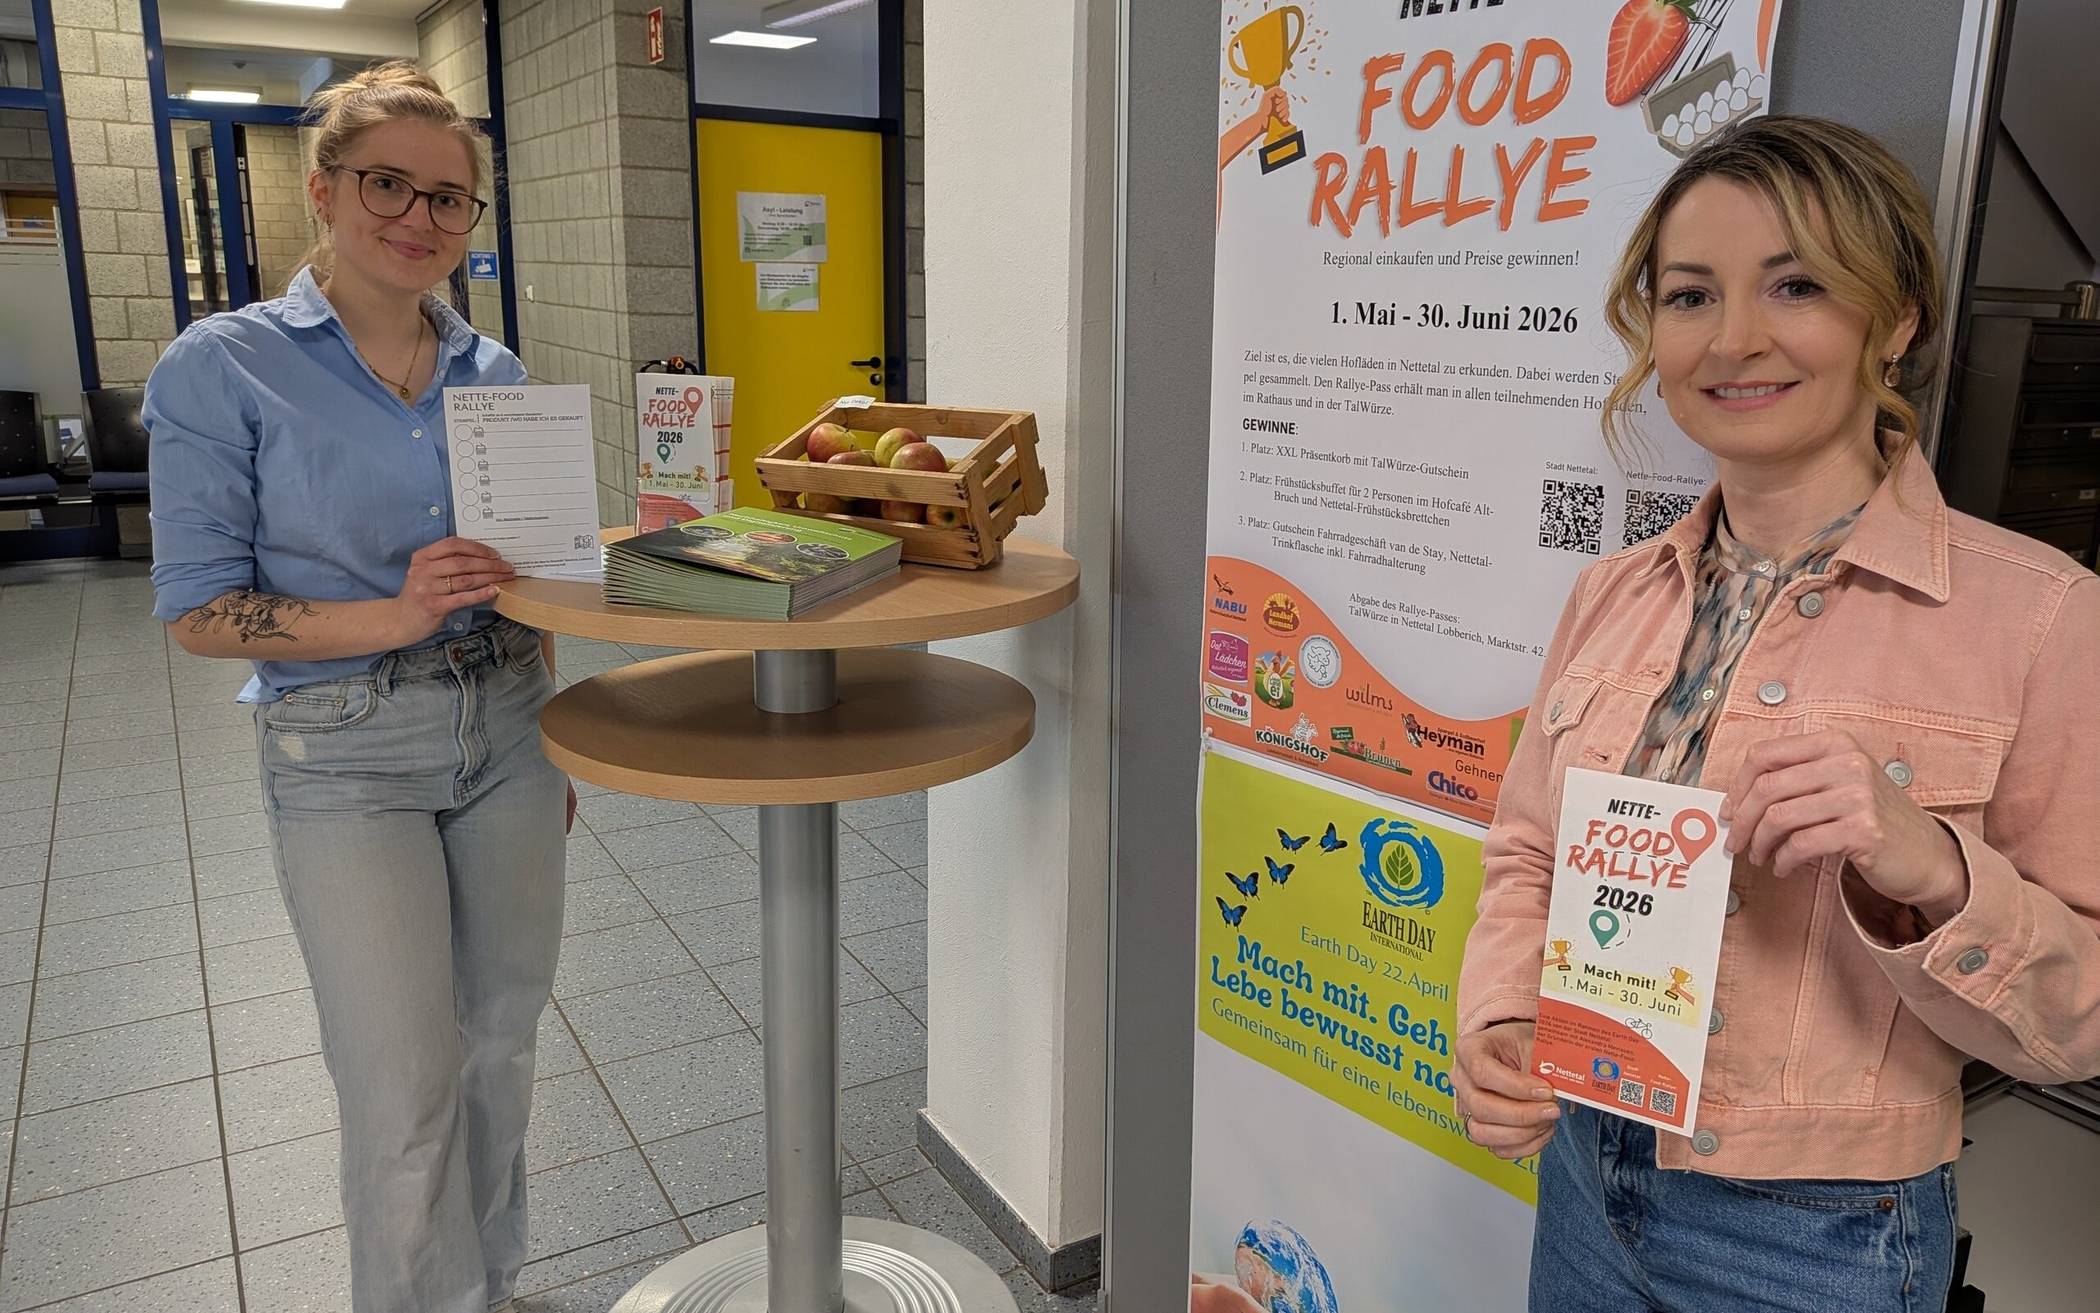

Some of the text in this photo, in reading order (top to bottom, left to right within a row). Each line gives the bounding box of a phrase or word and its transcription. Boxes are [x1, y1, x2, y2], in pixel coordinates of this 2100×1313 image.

[1359, 37, 1573, 144] FOOD
[1310, 136, 1597, 239] RALLYE
[1323, 250, 1579, 269] Regional einkaufen und Preise gewinnen!
[1331, 302, 1348, 324] 1.
[1354, 302, 1396, 326] Mai
[1417, 304, 1450, 328] 30.
[1457, 304, 1510, 330] Juni
[1517, 306, 1580, 333] 2026
[1244, 350, 1623, 385] Ziel ist es, die vielen Hofläden in Nettetal zu erkunden. Dabei werden Ste
[453, 392, 524, 402] NETTE-FOOD
[1243, 372, 1257, 385] pel
[1259, 374, 1310, 387] gesammelt.
[1314, 376, 1333, 388] Den
[1336, 377, 1392, 394] Rallye-Pass
[1394, 382, 1423, 396] erhält
[1426, 387, 1448, 398] man
[1452, 386, 1462, 398] in
[1465, 387, 1490, 401] allen
[1494, 390, 1579, 408] teilnehmenden
[1243, 391, 1394, 416] im Rathaus und in der TalWürze.
[454, 402, 494, 411] RALLYE
[642, 413, 696, 429] RALLYE
[649, 399, 687, 414] FOOD
[657, 431, 684, 444] 2026
[1242, 418, 1298, 435] GEWINNE:
[1242, 442, 1469, 479] 1. Platz: XXL Präsentkorb mit TalWürze-Gutschein
[1546, 462, 1598, 475] Stadt Nettetal:
[1240, 471, 1494, 516] 2. Platz: Frühstücksbuffet für 2 Personen im Hofcafé Alt-
[1626, 471, 1706, 486] Nette-Food-Rallye:
[1274, 490, 1450, 527] Bruch und Nettetal-Frühstücksbrettchen
[1238, 516, 1492, 567] 3. Platz: Gutschein Fahrradgeschäft van de Stay, Nettetal-
[1272, 536, 1426, 576] Trinkflasche inkl. Fahrradhalterung
[1215, 598, 1248, 614] NABU
[1349, 592, 1460, 624] Abgabe des Rallye-Passes:
[1349, 605, 1547, 658] TalWürze in Nettetal Lobberich, Marktstr. 42.
[1208, 696, 1248, 718] Clemens
[1346, 684, 1393, 710] wilms
[1418, 724, 1485, 756] Heyman
[1428, 770, 1478, 800] Chico
[1455, 759, 1504, 783] Gehnen
[1607, 798, 1662, 820] NETTE-
[1585, 820, 1676, 856] FOOD
[1567, 844, 1690, 889] RALLYE
[1593, 884, 1654, 916] 2026
[1362, 900, 1436, 953] EARTH DAY
[1301, 925, 1342, 956] Earth
[1347, 944, 1378, 974] Day
[1370, 932, 1424, 962] INTERNATIONAL
[1584, 963, 1656, 991] Mach mit!
[1238, 934, 1449, 1056] Mach mit. Geh
[1620, 989, 1642, 1006] 30.
[1648, 998, 1682, 1016] Juni
[1211, 955, 1272, 1008] Lebe
[1281, 987, 1404, 1072] bewusst
[1212, 997, 1308, 1058] Gemeinsam
[1313, 1046, 1338, 1072] für
[1343, 1065, 1380, 1094] eine
[1556, 1066, 1585, 1081] Nettetal
